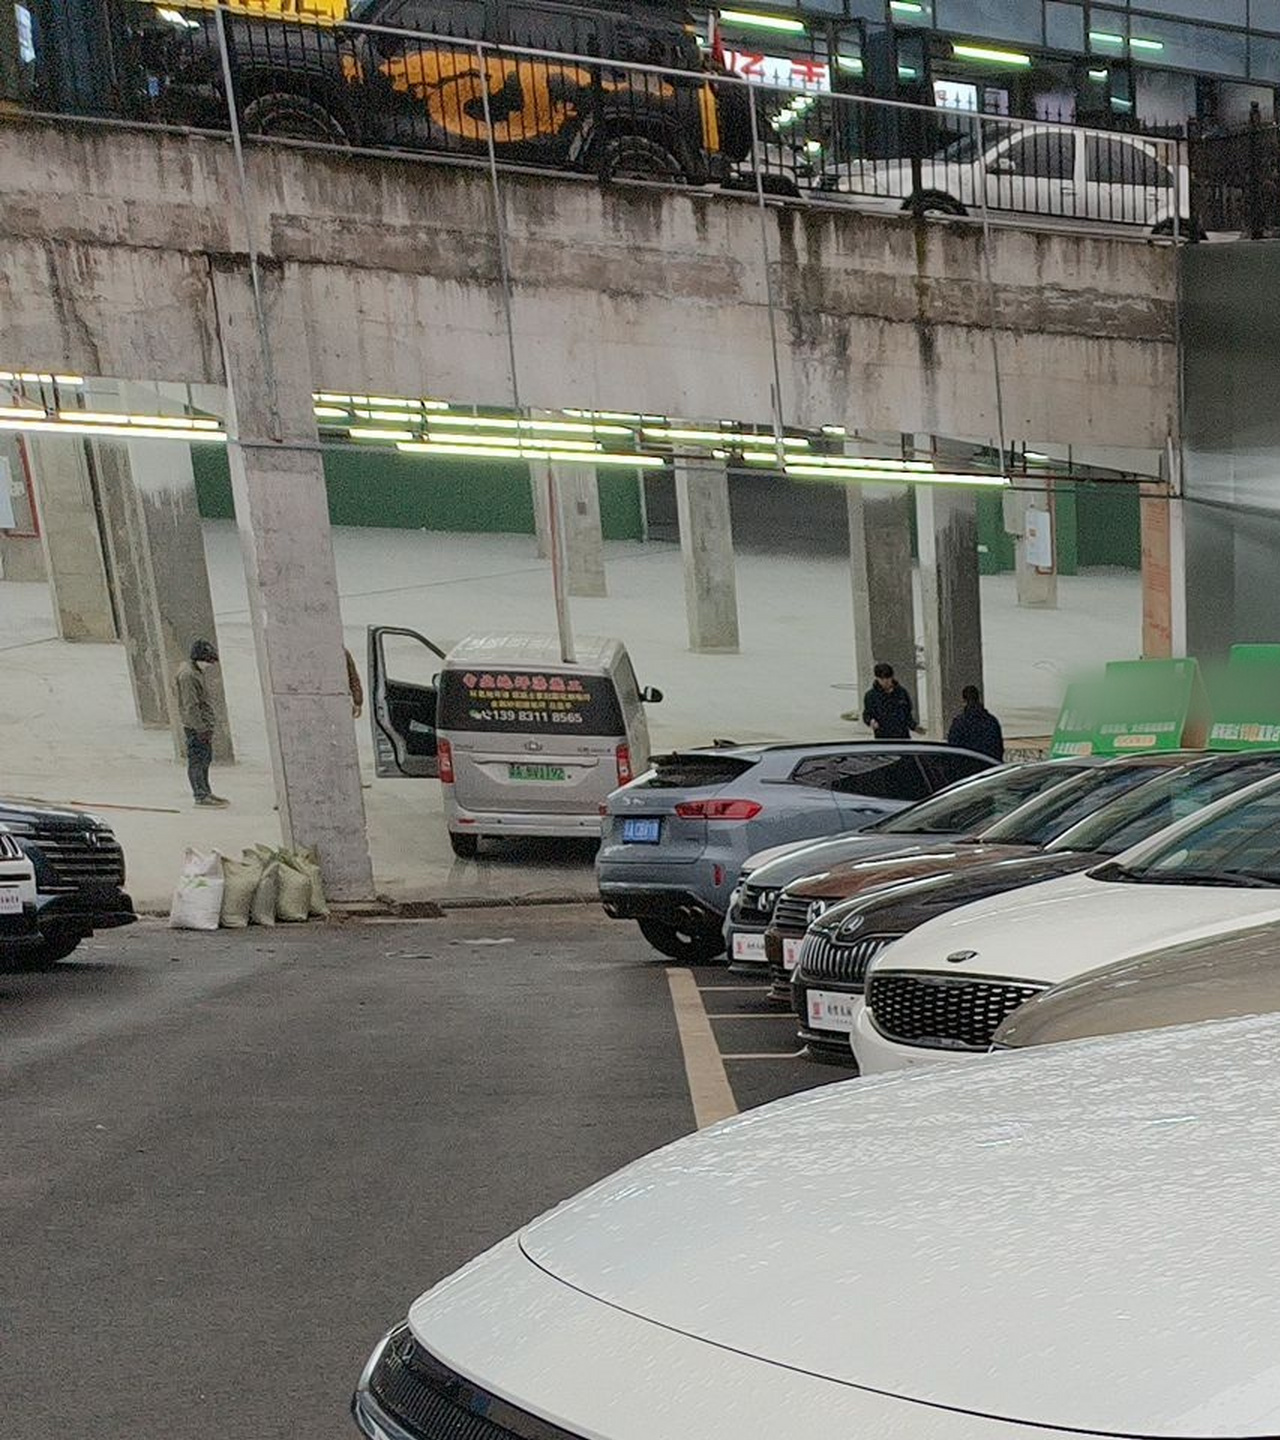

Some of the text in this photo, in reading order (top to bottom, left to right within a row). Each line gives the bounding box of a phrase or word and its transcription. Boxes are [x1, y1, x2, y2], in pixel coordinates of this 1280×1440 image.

[493, 710, 583, 723] 139 8311 8565
